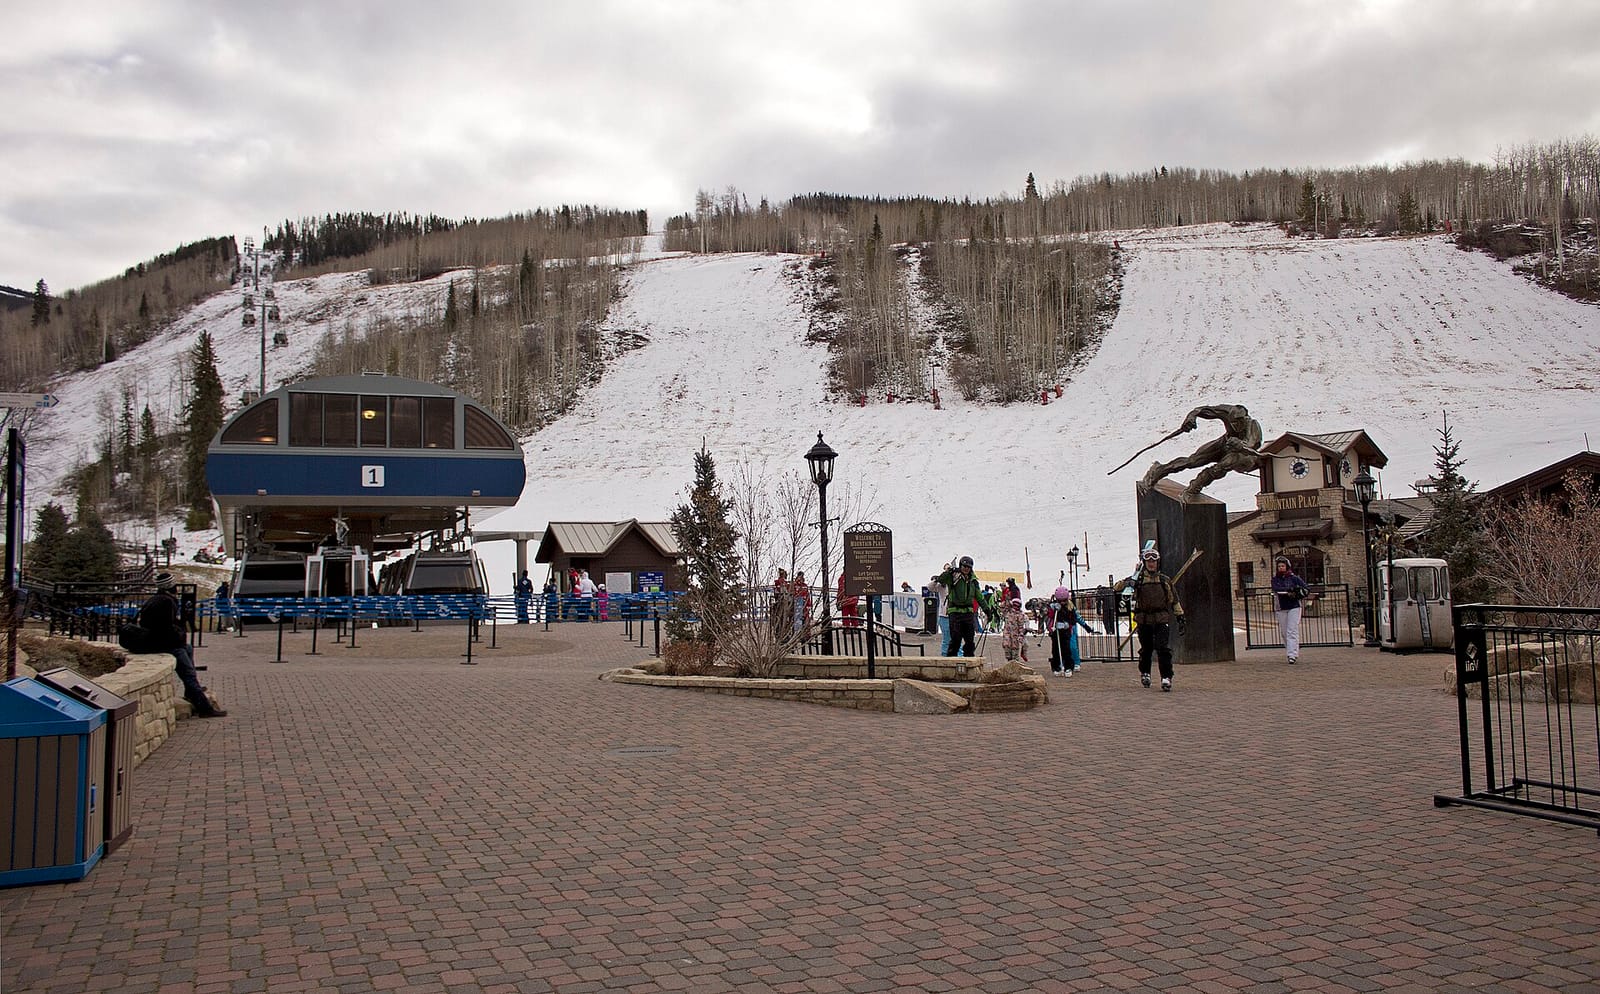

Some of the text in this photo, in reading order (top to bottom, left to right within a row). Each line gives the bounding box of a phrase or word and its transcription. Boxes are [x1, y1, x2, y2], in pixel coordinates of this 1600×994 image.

[368, 468, 379, 484] 1
[1264, 495, 1321, 511] MOUNTAIN PLAZA
